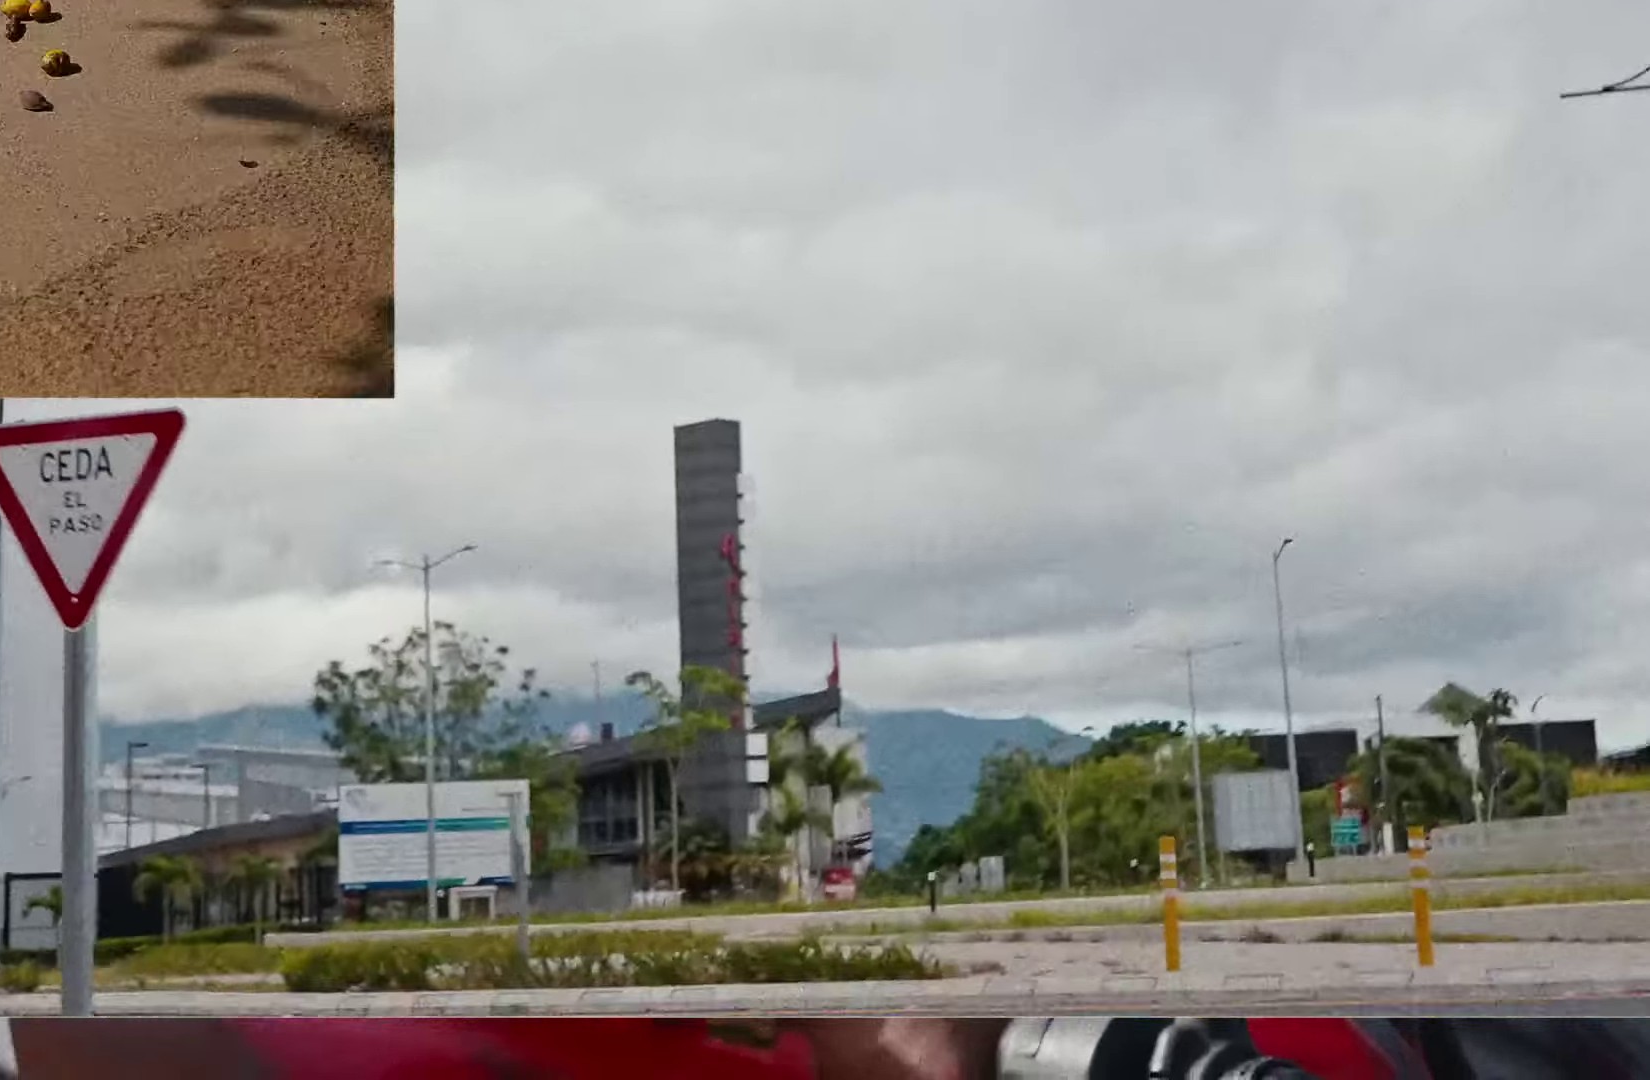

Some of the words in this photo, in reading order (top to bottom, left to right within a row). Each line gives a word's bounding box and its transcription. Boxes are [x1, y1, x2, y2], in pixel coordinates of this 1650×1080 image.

[40, 446, 113, 483] CEDA
[63, 491, 87, 508] EL
[50, 513, 102, 534] PASO
